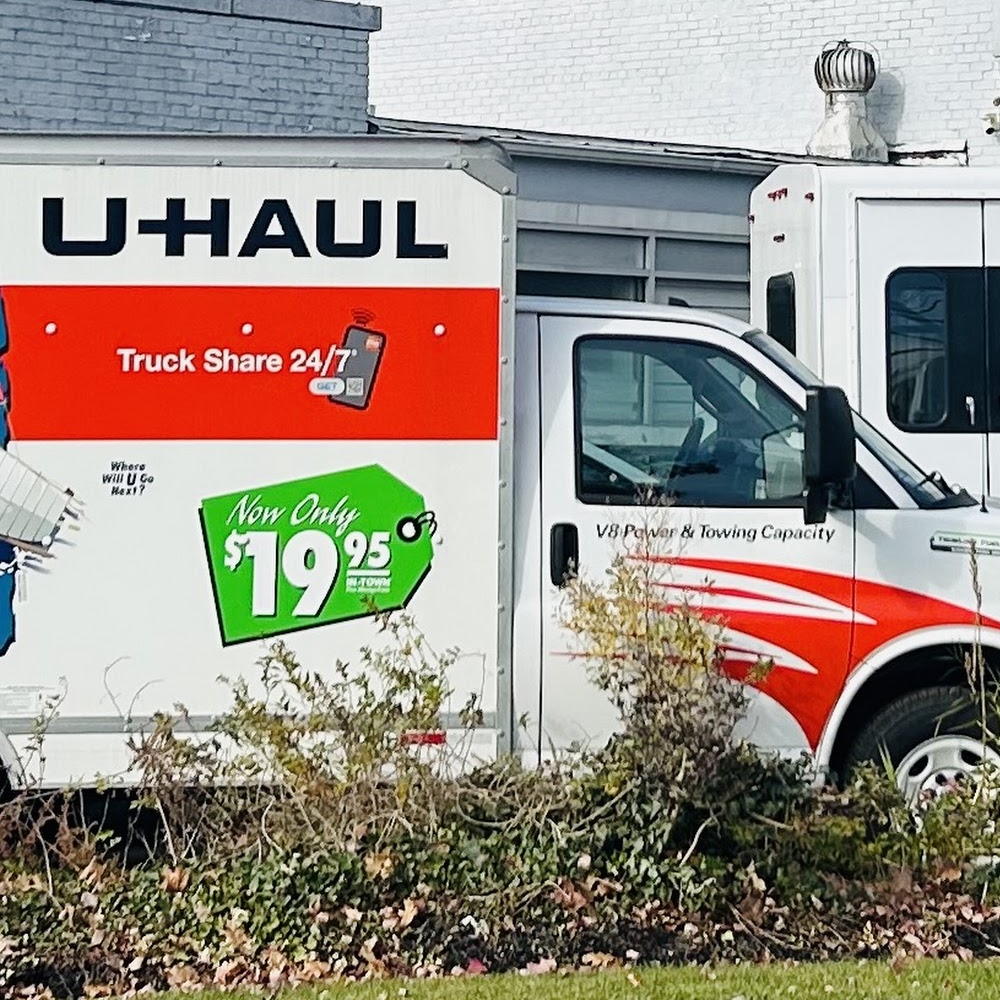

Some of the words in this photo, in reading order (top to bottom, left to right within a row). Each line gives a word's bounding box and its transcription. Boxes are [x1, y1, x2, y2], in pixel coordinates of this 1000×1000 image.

[42, 197, 449, 260] U-HAUL
[116, 348, 195, 372] Truck
[203, 348, 283, 373] Share
[111, 460, 146, 471] Where
[102, 473, 124, 484] Will
[127, 472, 137, 486] U
[140, 473, 154, 483] Go
[226, 494, 287, 526] Now
[290, 493, 361, 538] Only
[596, 523, 620, 539] V8
[680, 523, 695, 539] &
[699, 523, 758, 542] Towing
[761, 524, 837, 543] Capacity
